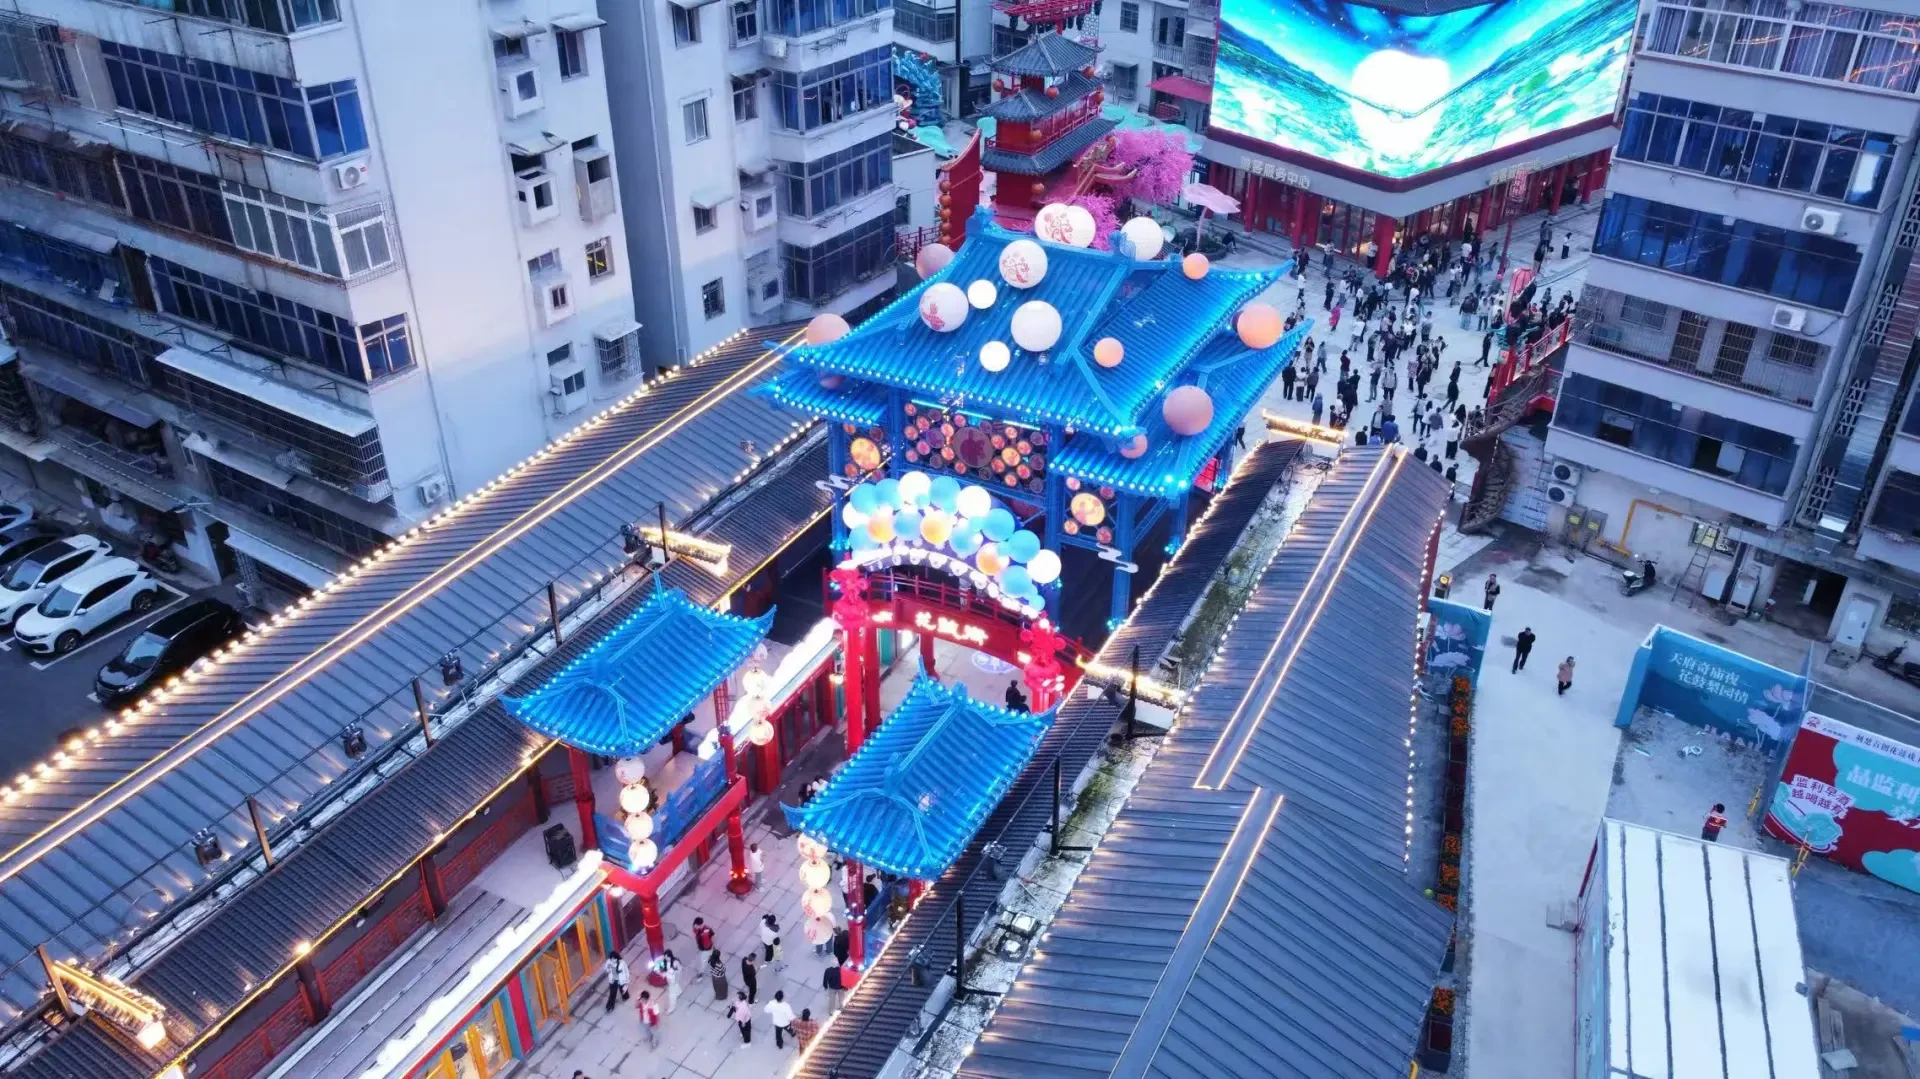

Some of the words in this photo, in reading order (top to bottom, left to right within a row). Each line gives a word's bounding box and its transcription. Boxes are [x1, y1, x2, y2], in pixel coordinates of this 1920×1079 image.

[1791, 788, 1845, 816] 越喝越有
[1795, 776, 1851, 807] 监利早酒
